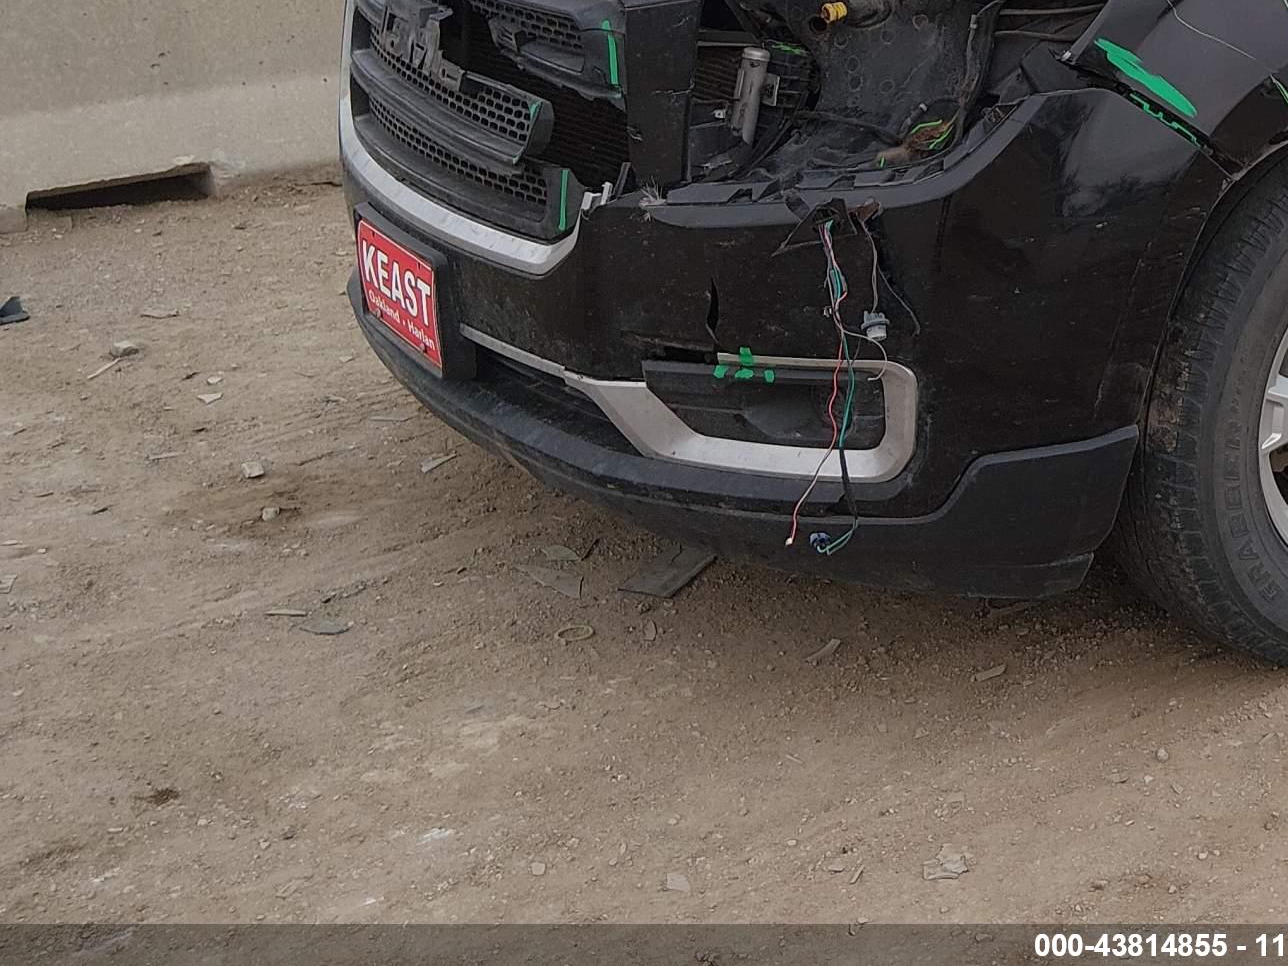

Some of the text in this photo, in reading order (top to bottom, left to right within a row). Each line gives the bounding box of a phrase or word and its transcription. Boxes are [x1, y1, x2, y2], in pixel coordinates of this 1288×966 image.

[362, 239, 431, 327] KEAST
[368, 289, 436, 352] Oakland Harlan
